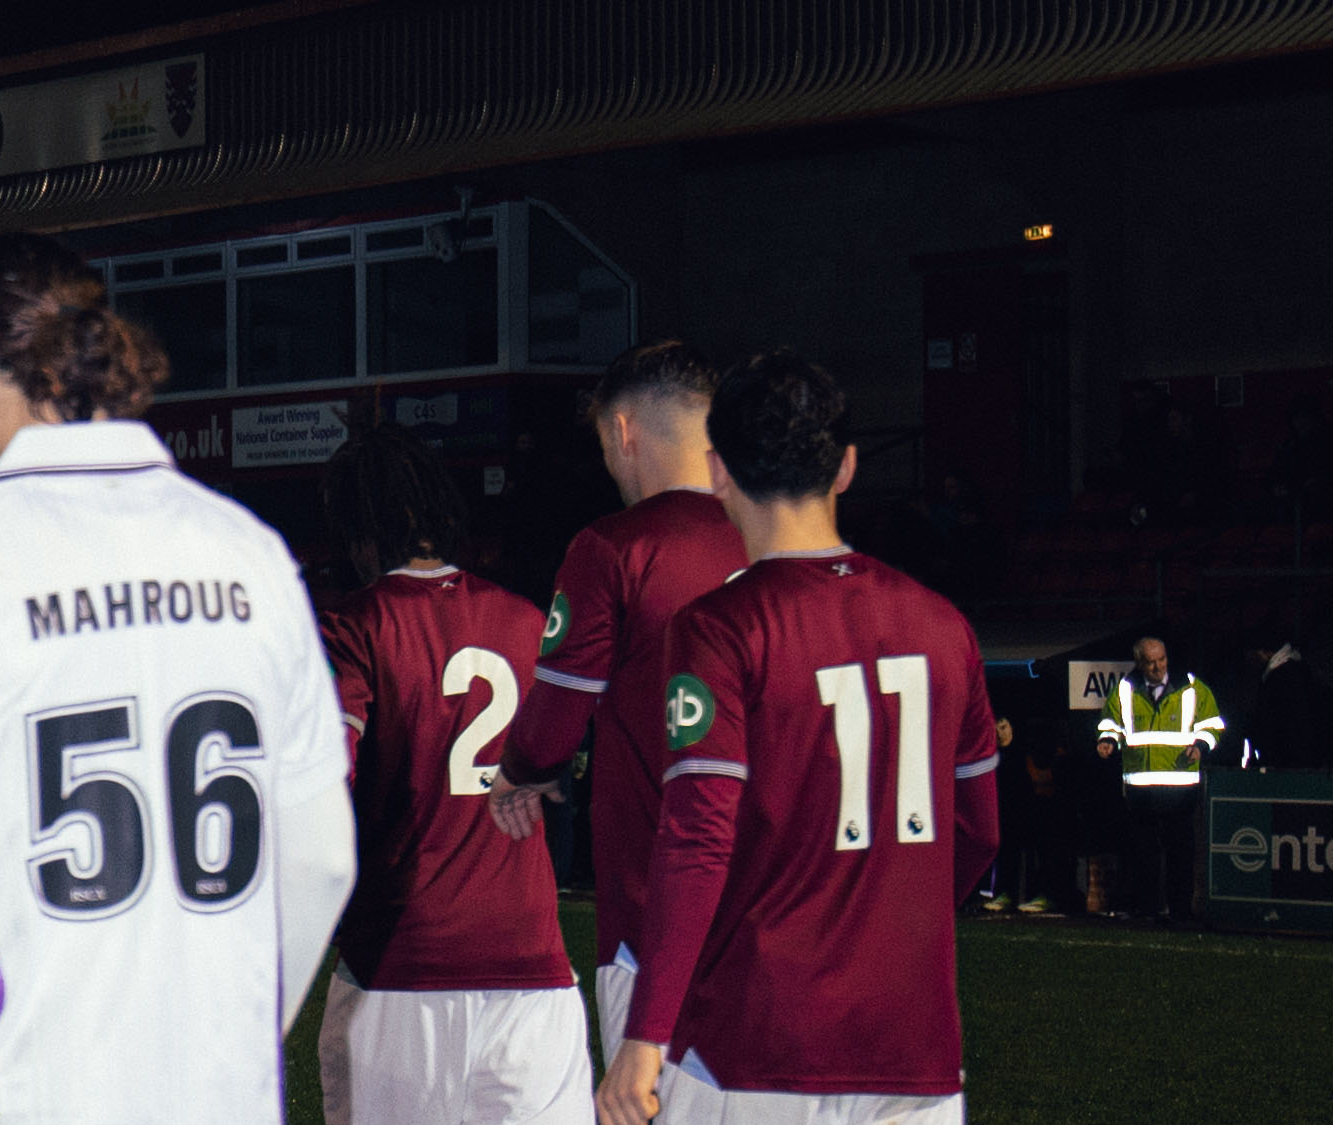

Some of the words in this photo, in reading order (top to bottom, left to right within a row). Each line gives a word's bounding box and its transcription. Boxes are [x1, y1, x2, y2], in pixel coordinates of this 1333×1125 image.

[236, 429, 269, 445] National
[270, 427, 309, 443] Container
[311, 425, 344, 442] Supplier
[258, 409, 284, 425] Award
[286, 409, 320, 425] Winning
[26, 579, 252, 640] MAHROUG
[1084, 671, 1125, 699] AW
[442, 646, 520, 795] 2
[815, 654, 936, 851] 11
[26, 689, 266, 923] 56
